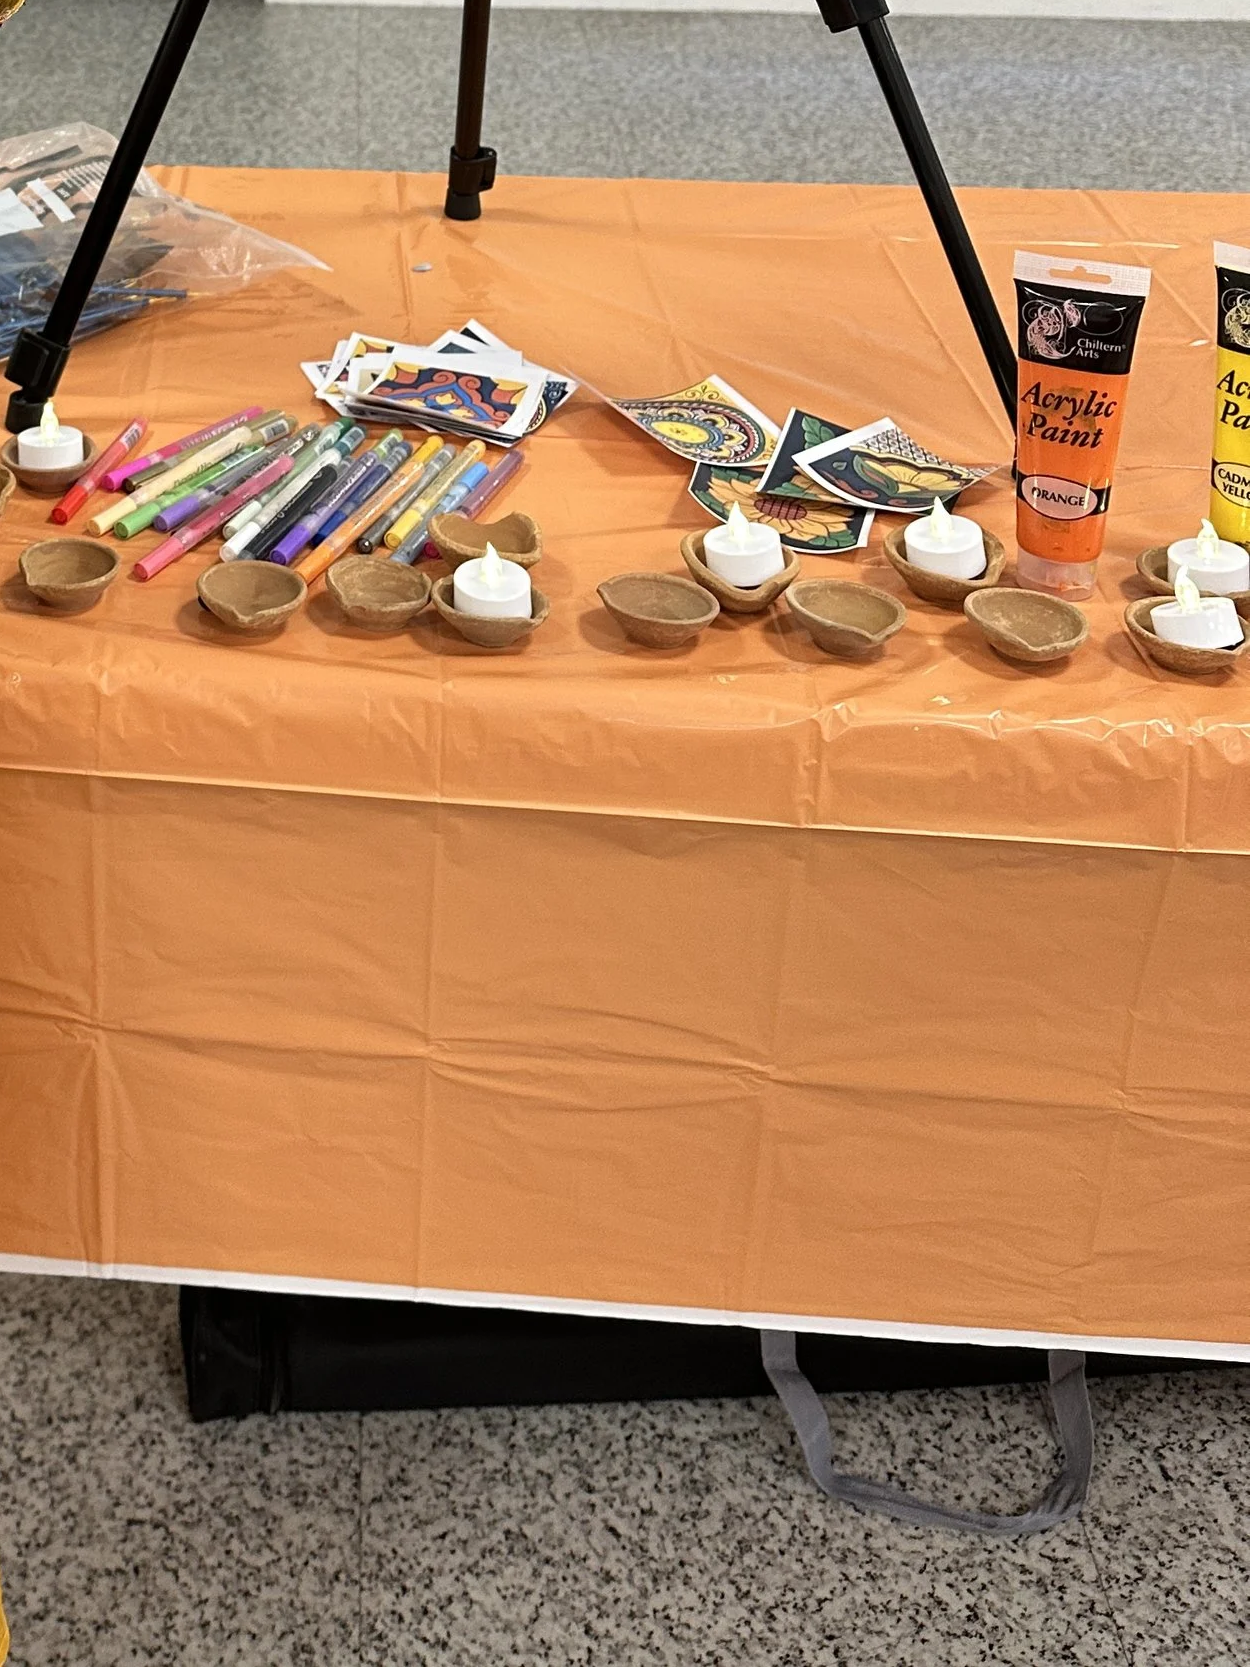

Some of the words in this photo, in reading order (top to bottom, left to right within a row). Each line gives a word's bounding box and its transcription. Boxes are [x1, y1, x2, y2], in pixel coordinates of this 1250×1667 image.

[1075, 347, 1100, 359] Arts
[1021, 381, 1117, 420] Acrylic
[1027, 411, 1104, 449] Paint
[1031, 486, 1086, 507] ORANGE
